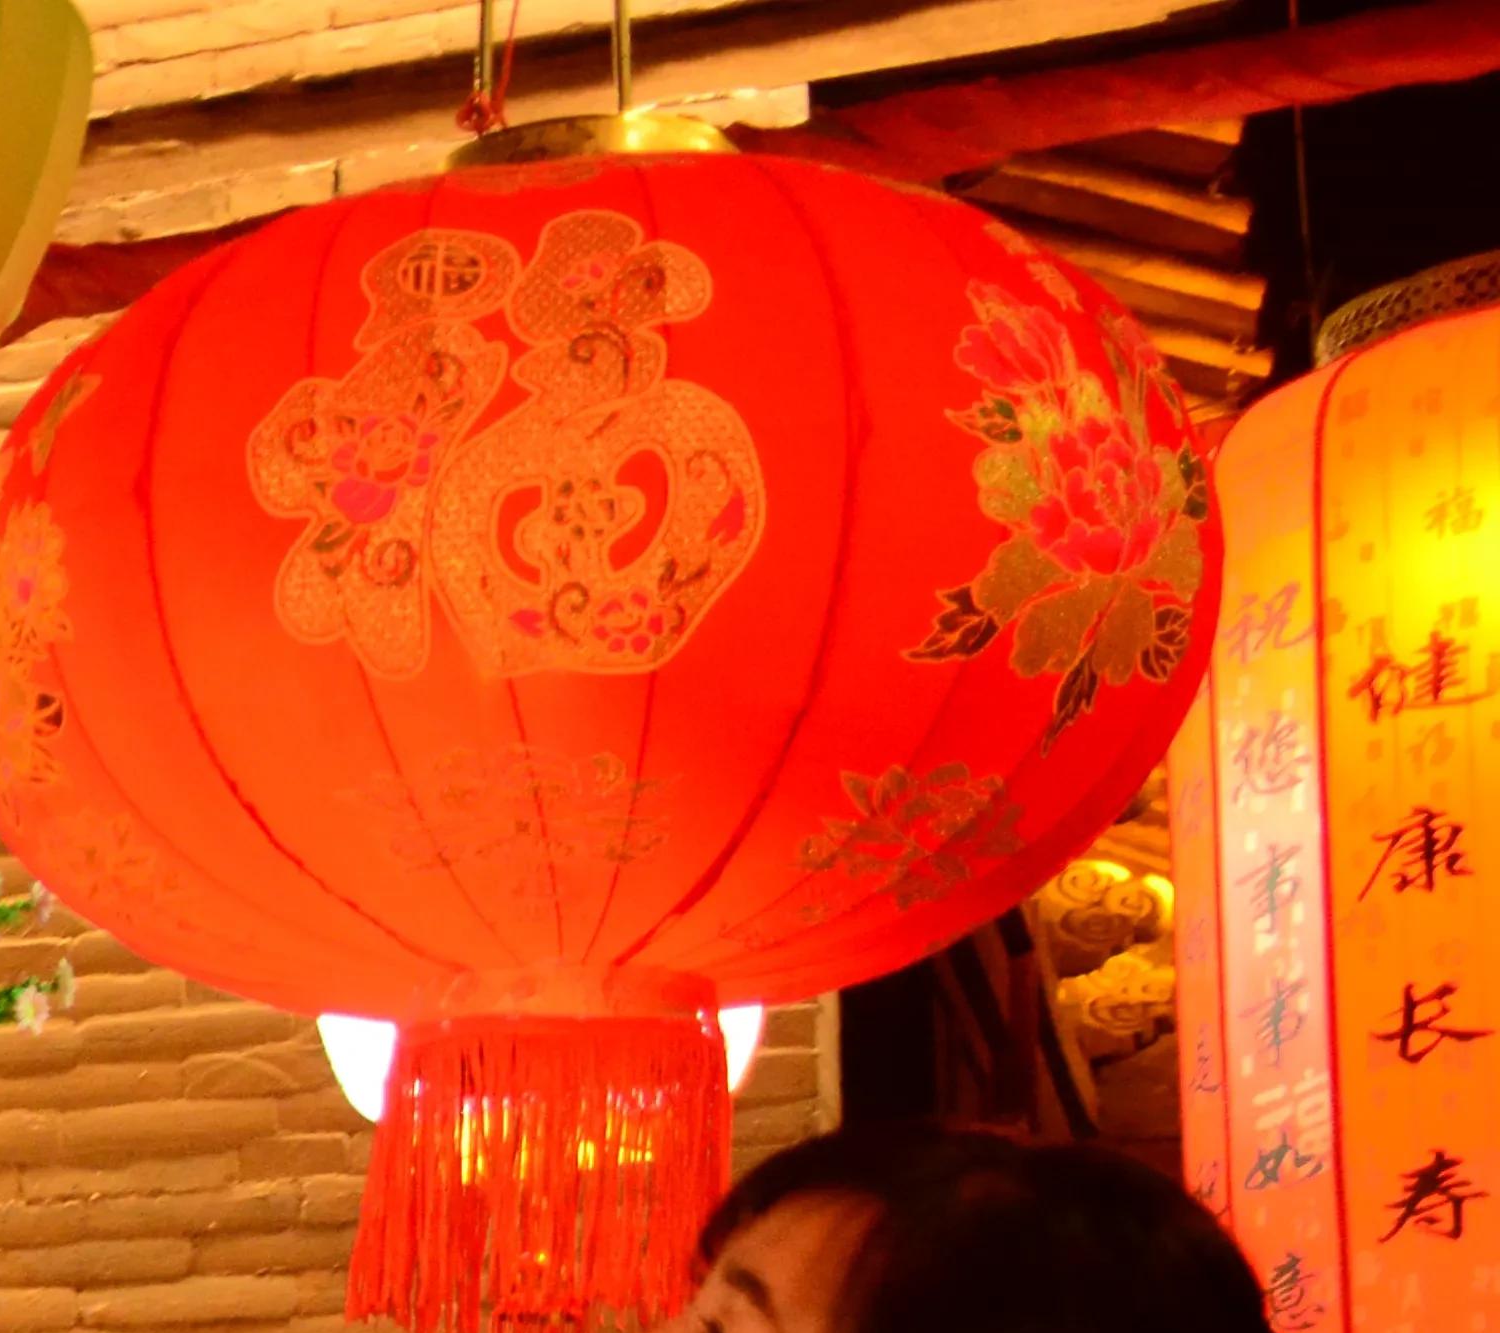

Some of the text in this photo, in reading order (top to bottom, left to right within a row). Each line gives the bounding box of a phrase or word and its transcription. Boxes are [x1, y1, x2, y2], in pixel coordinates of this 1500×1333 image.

[1224, 582, 1325, 1332] 祝您事事如意
[1349, 630, 1498, 1247] 健康长寿
